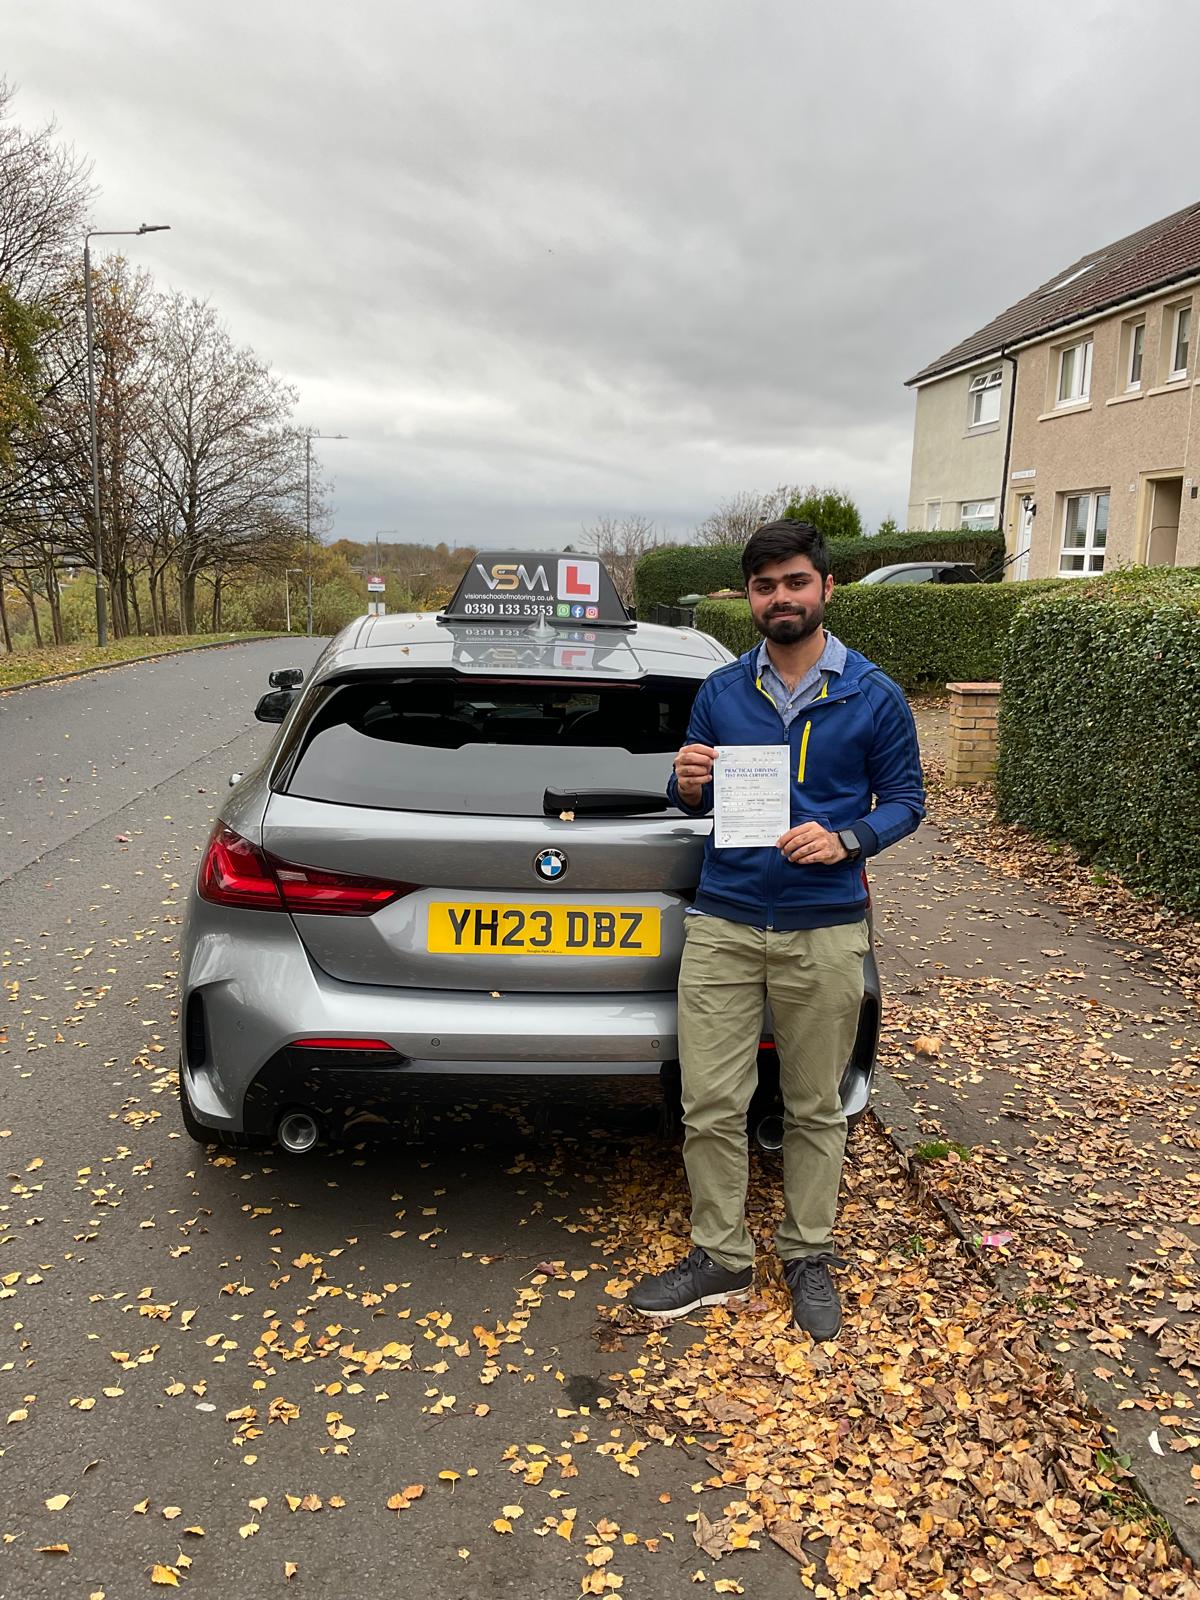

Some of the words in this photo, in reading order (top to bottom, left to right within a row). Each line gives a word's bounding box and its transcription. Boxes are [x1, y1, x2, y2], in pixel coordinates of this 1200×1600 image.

[476, 564, 549, 591] VSM
[566, 566, 591, 594] L
[464, 594, 554, 602] visionschoolofmotoring.co.uk
[464, 604, 494, 614] 0330
[498, 604, 520, 615] 133
[524, 604, 554, 616] 5353
[538, 850, 566, 861] BMW
[448, 909, 552, 947] YH23
[566, 911, 643, 949] DBZ
